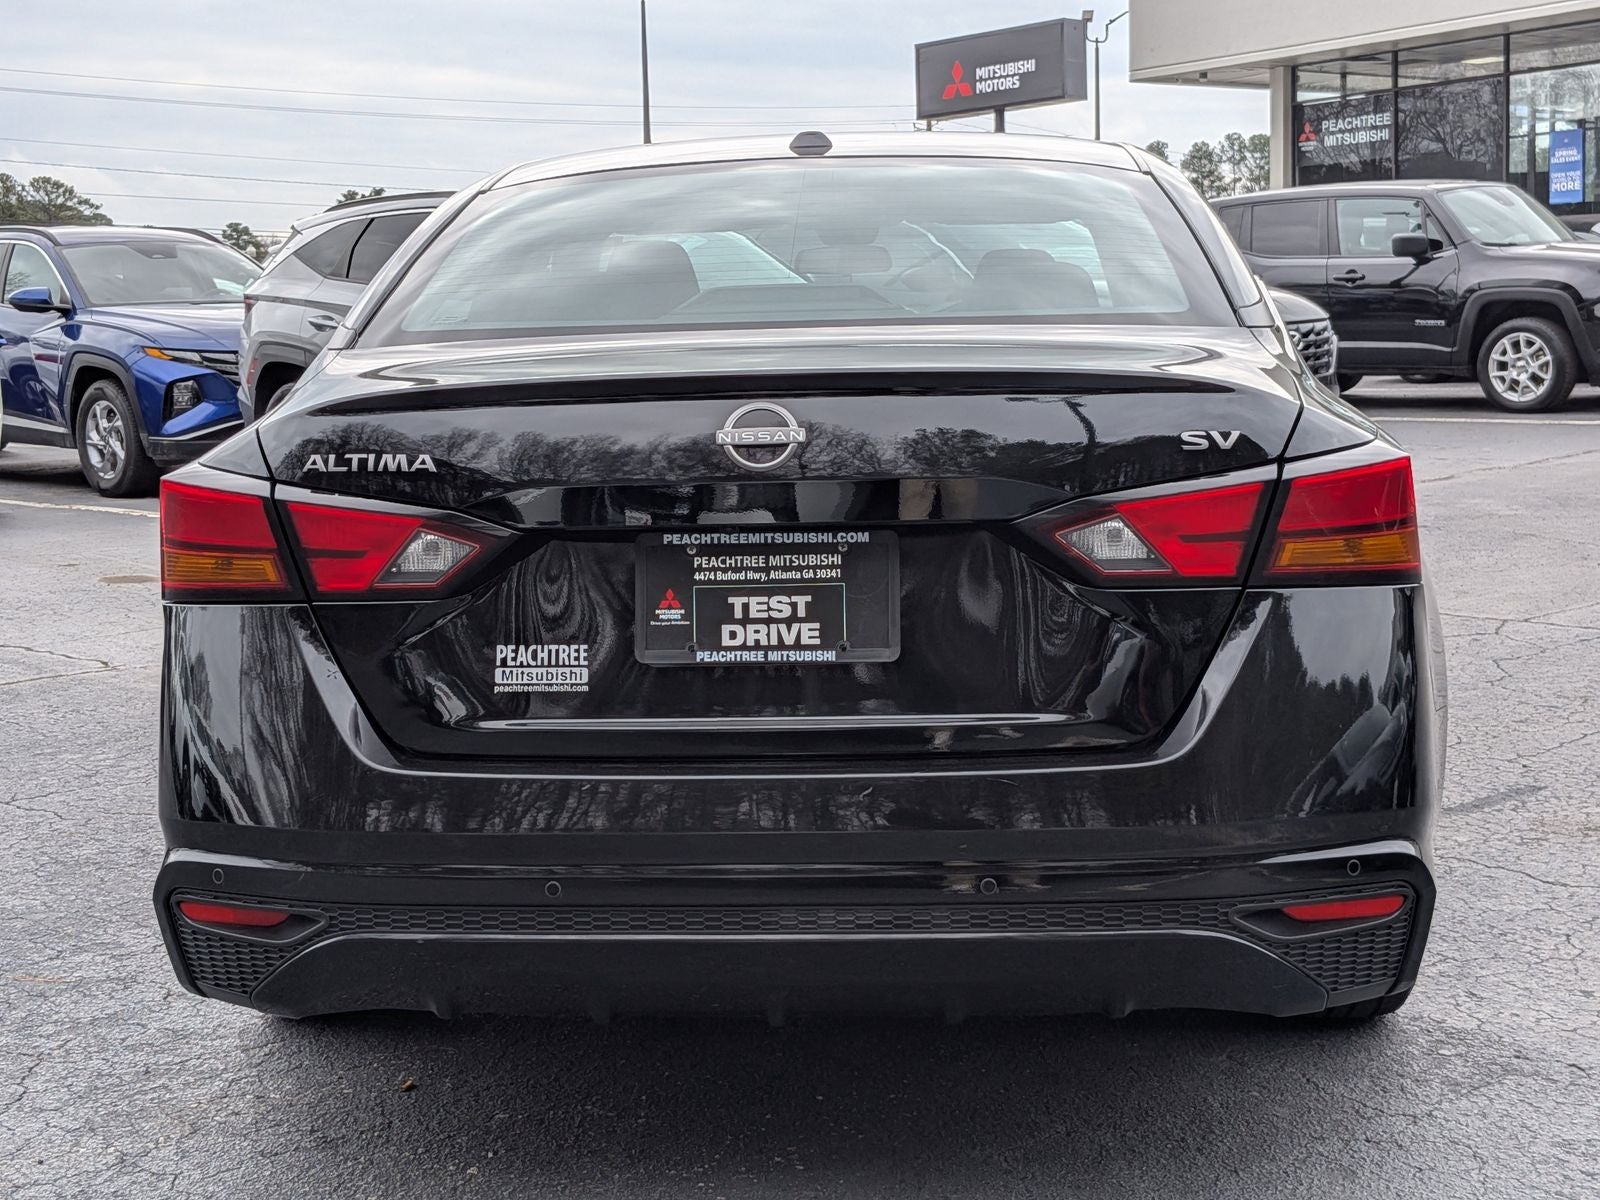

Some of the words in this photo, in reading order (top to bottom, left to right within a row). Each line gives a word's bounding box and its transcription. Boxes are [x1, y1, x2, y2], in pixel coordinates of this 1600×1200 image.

[975, 58, 1036, 80] MITSUBISHI
[975, 75, 1021, 94] MOTORS
[1321, 112, 1392, 132] PEACHTREE
[1323, 128, 1389, 147] MITSUBISHI
[1552, 181, 1582, 192] MORE
[718, 430, 803, 443] NISSAN
[1180, 430, 1241, 451] SV
[302, 453, 437, 472] ALTIMA
[663, 532, 870, 545] PEACHTREEMITSUBISHI.COM
[693, 555, 766, 568] PEACHTREE
[769, 553, 842, 566] MITSUBISHI
[693, 572, 715, 581] 4474
[716, 570, 746, 581] Buford
[747, 570, 768, 582] Hwy,
[769, 569, 801, 580] Atlanta
[802, 569, 815, 579] GA
[815, 568, 841, 579] 30341
[727, 595, 812, 619] TEST
[721, 622, 820, 647] DRIVE
[496, 644, 589, 667] PEACHTREE
[696, 651, 765, 662] PEACHTREE
[767, 650, 836, 661] MITSUBISHI
[501, 669, 583, 682] Mitsubishi
[494, 684, 589, 694] peachtreemitsubishi.com
